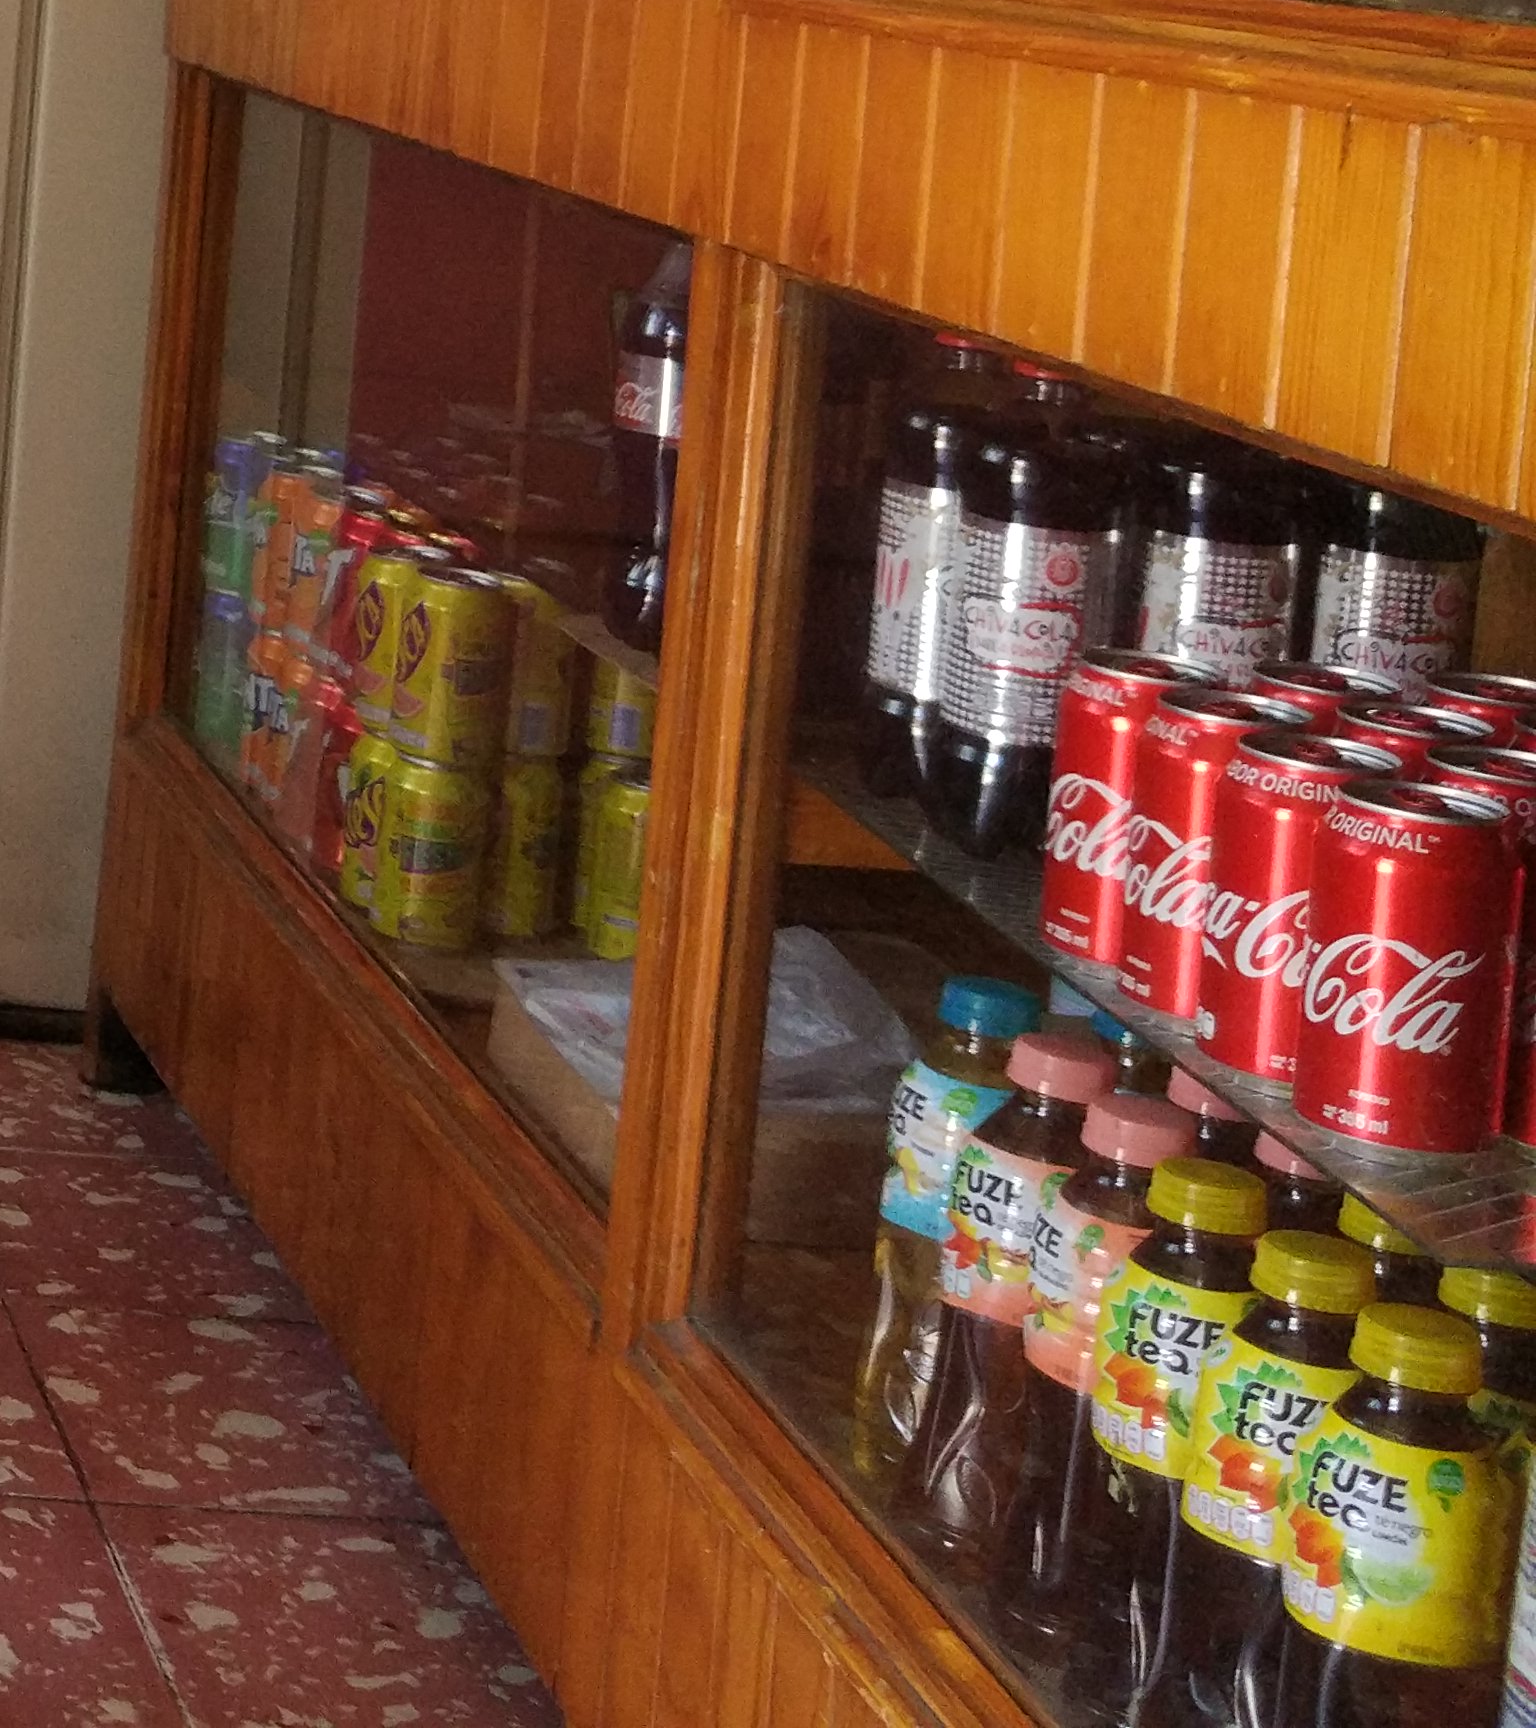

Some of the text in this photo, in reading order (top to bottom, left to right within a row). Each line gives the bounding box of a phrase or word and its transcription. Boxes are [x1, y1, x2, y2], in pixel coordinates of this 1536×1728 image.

[1259, 772, 1341, 804] ORIGIN
[1125, 1330, 1191, 1376] tea
[1238, 1381, 1331, 1429] FUZ
[1312, 1449, 1409, 1514] FUZE
